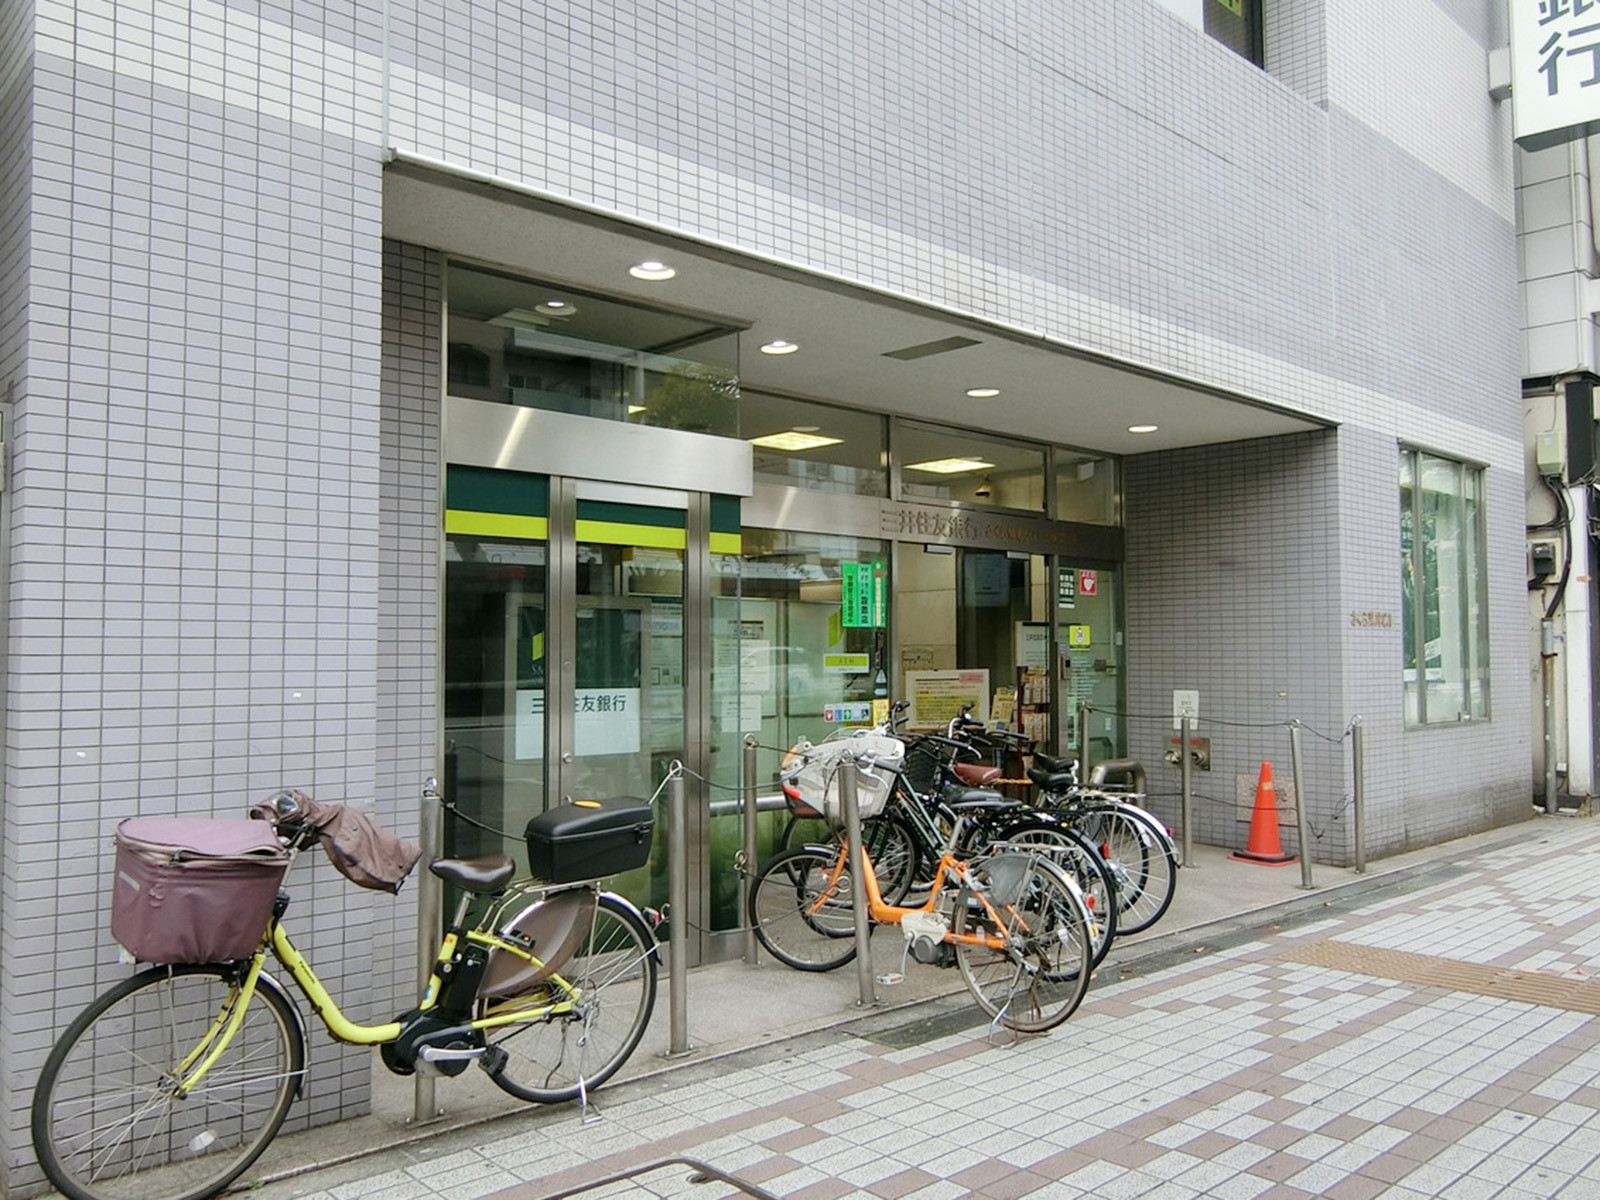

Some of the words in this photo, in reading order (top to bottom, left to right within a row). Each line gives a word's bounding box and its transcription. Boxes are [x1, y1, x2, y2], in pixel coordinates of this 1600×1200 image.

[881, 509, 977, 540] 三井住友銀行
